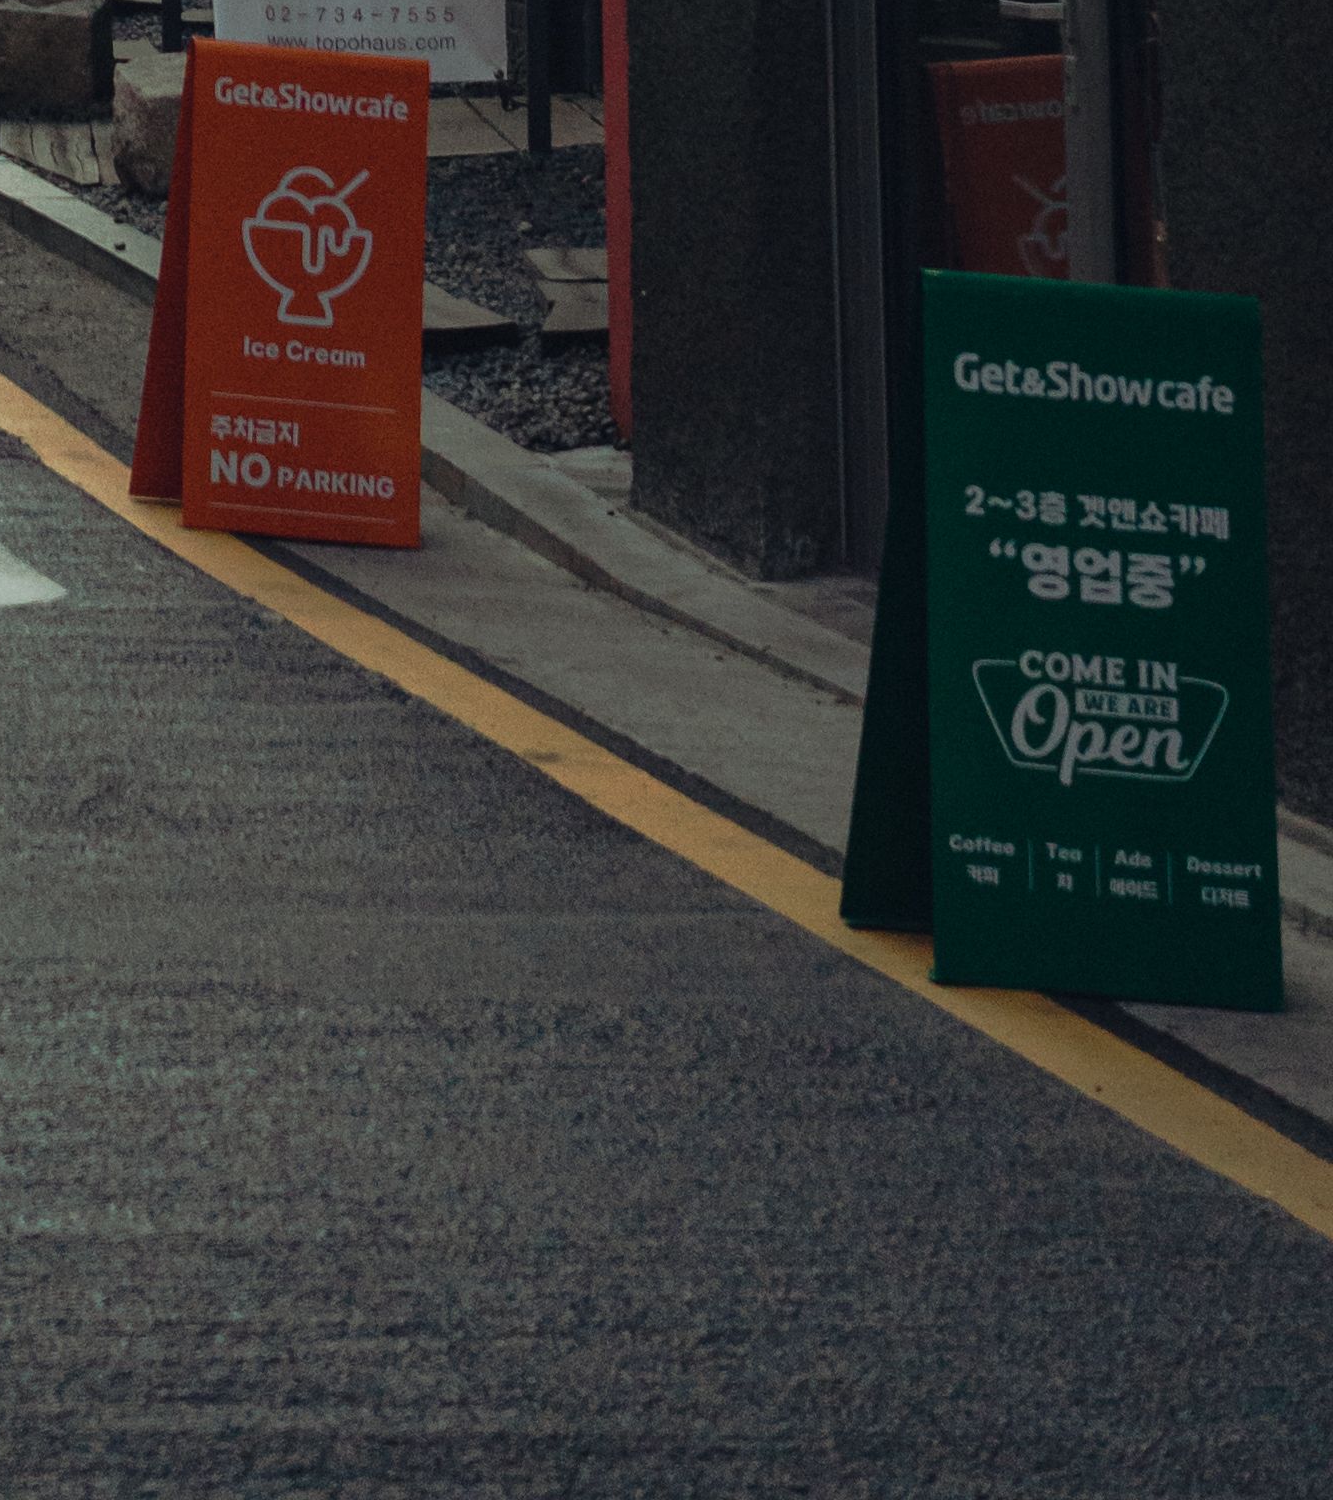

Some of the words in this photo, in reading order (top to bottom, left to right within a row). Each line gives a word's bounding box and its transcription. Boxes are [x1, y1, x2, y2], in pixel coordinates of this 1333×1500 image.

[264, 4, 456, 24] 02-734-7555
[356, 92, 409, 122] cafe
[243, 334, 280, 362] Ice
[285, 339, 366, 369] Cream
[1156, 375, 1235, 415] cafe
[209, 414, 300, 446] 주차금지
[209, 449, 272, 488] NO
[277, 469, 395, 500] PARKING
[1018, 649, 1127, 688] COME
[1137, 658, 1178, 692] IN
[1082, 692, 1118, 709] WE
[1125, 696, 1172, 716] ARE
[1010, 682, 1191, 788] Open
[948, 833, 1016, 857] Coffee
[1045, 841, 1082, 863] Tea
[1114, 848, 1153, 870] Ade
[1185, 854, 1263, 880] Dessert
[965, 863, 1000, 887] 커피
[1200, 885, 1251, 909] 디저트
